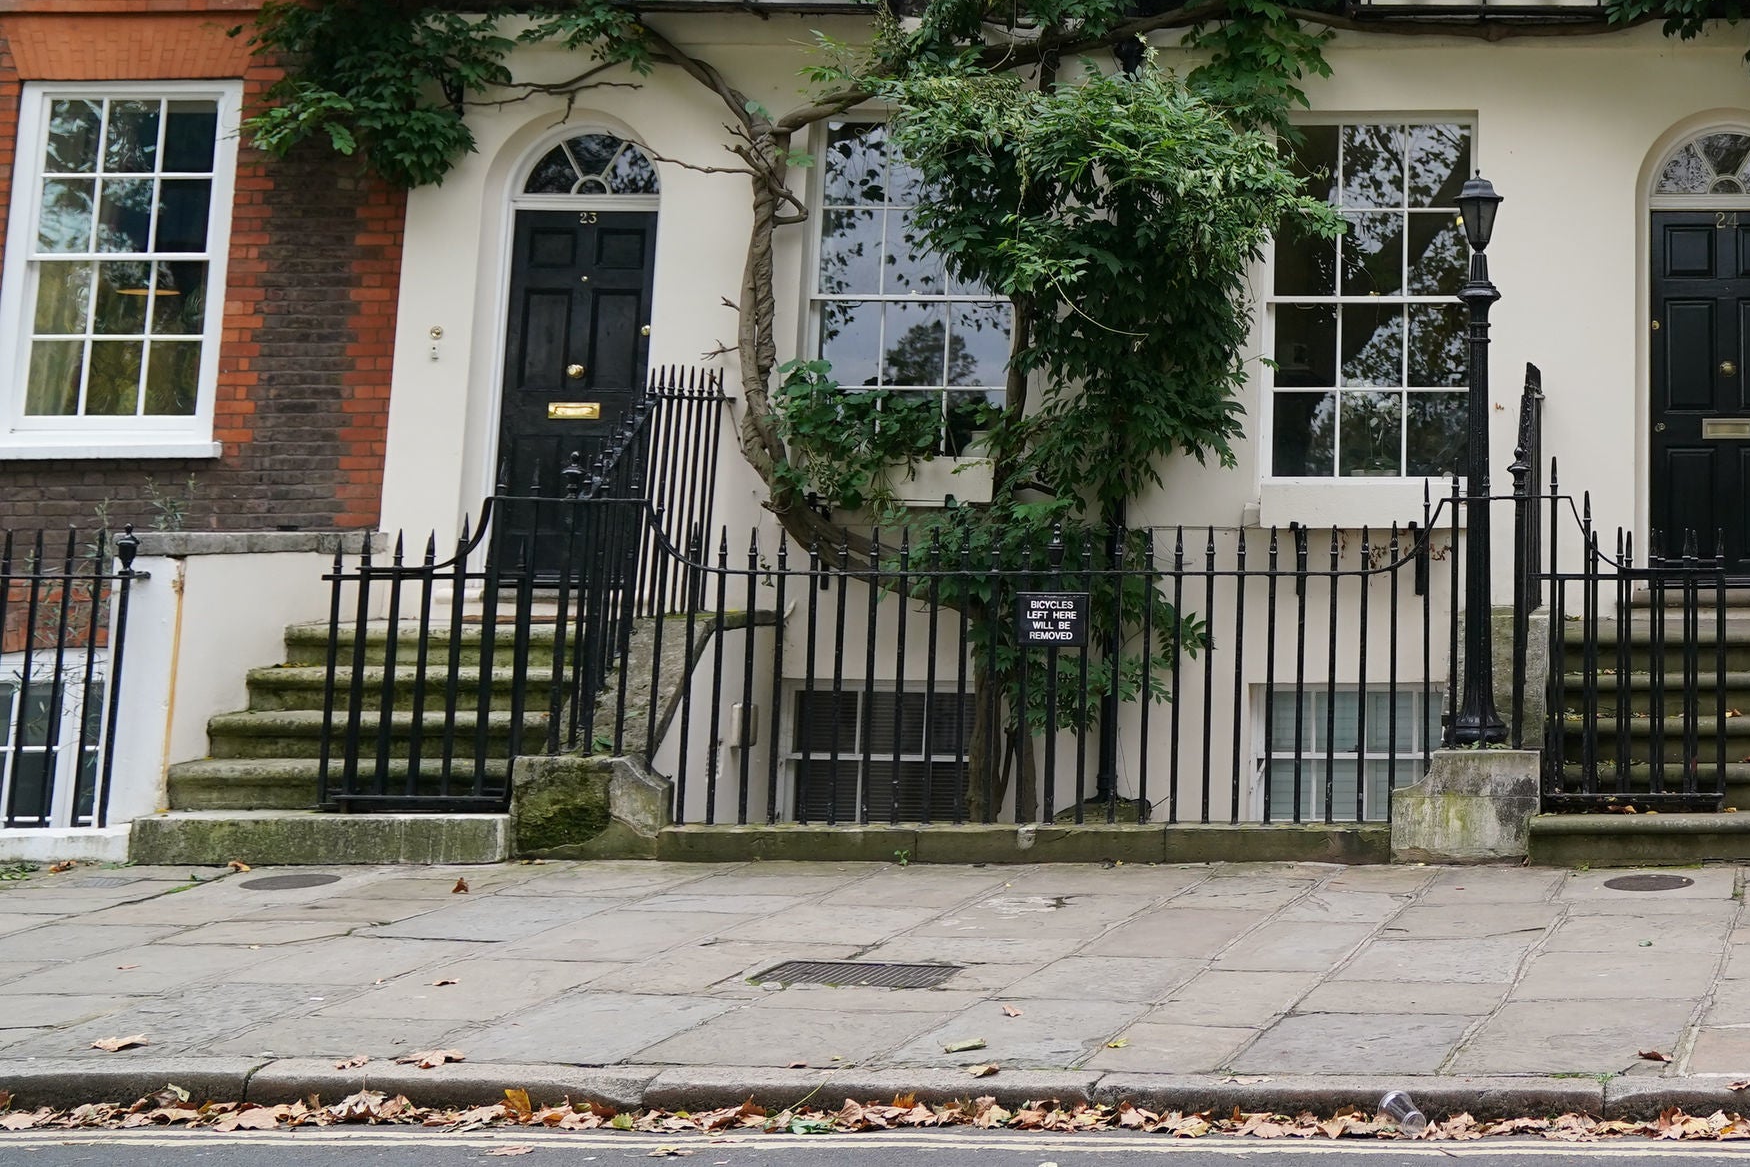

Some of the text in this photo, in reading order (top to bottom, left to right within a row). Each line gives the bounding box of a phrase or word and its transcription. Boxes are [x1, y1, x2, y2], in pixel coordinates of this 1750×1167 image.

[579, 212, 597, 224] 23
[1715, 211, 1739, 229] 24
[1030, 600, 1074, 609] BICYCLES
[1026, 610, 1077, 620] LEFT HERE
[1032, 621, 1071, 629] WILL BE
[1029, 631, 1073, 640] REMOVED
